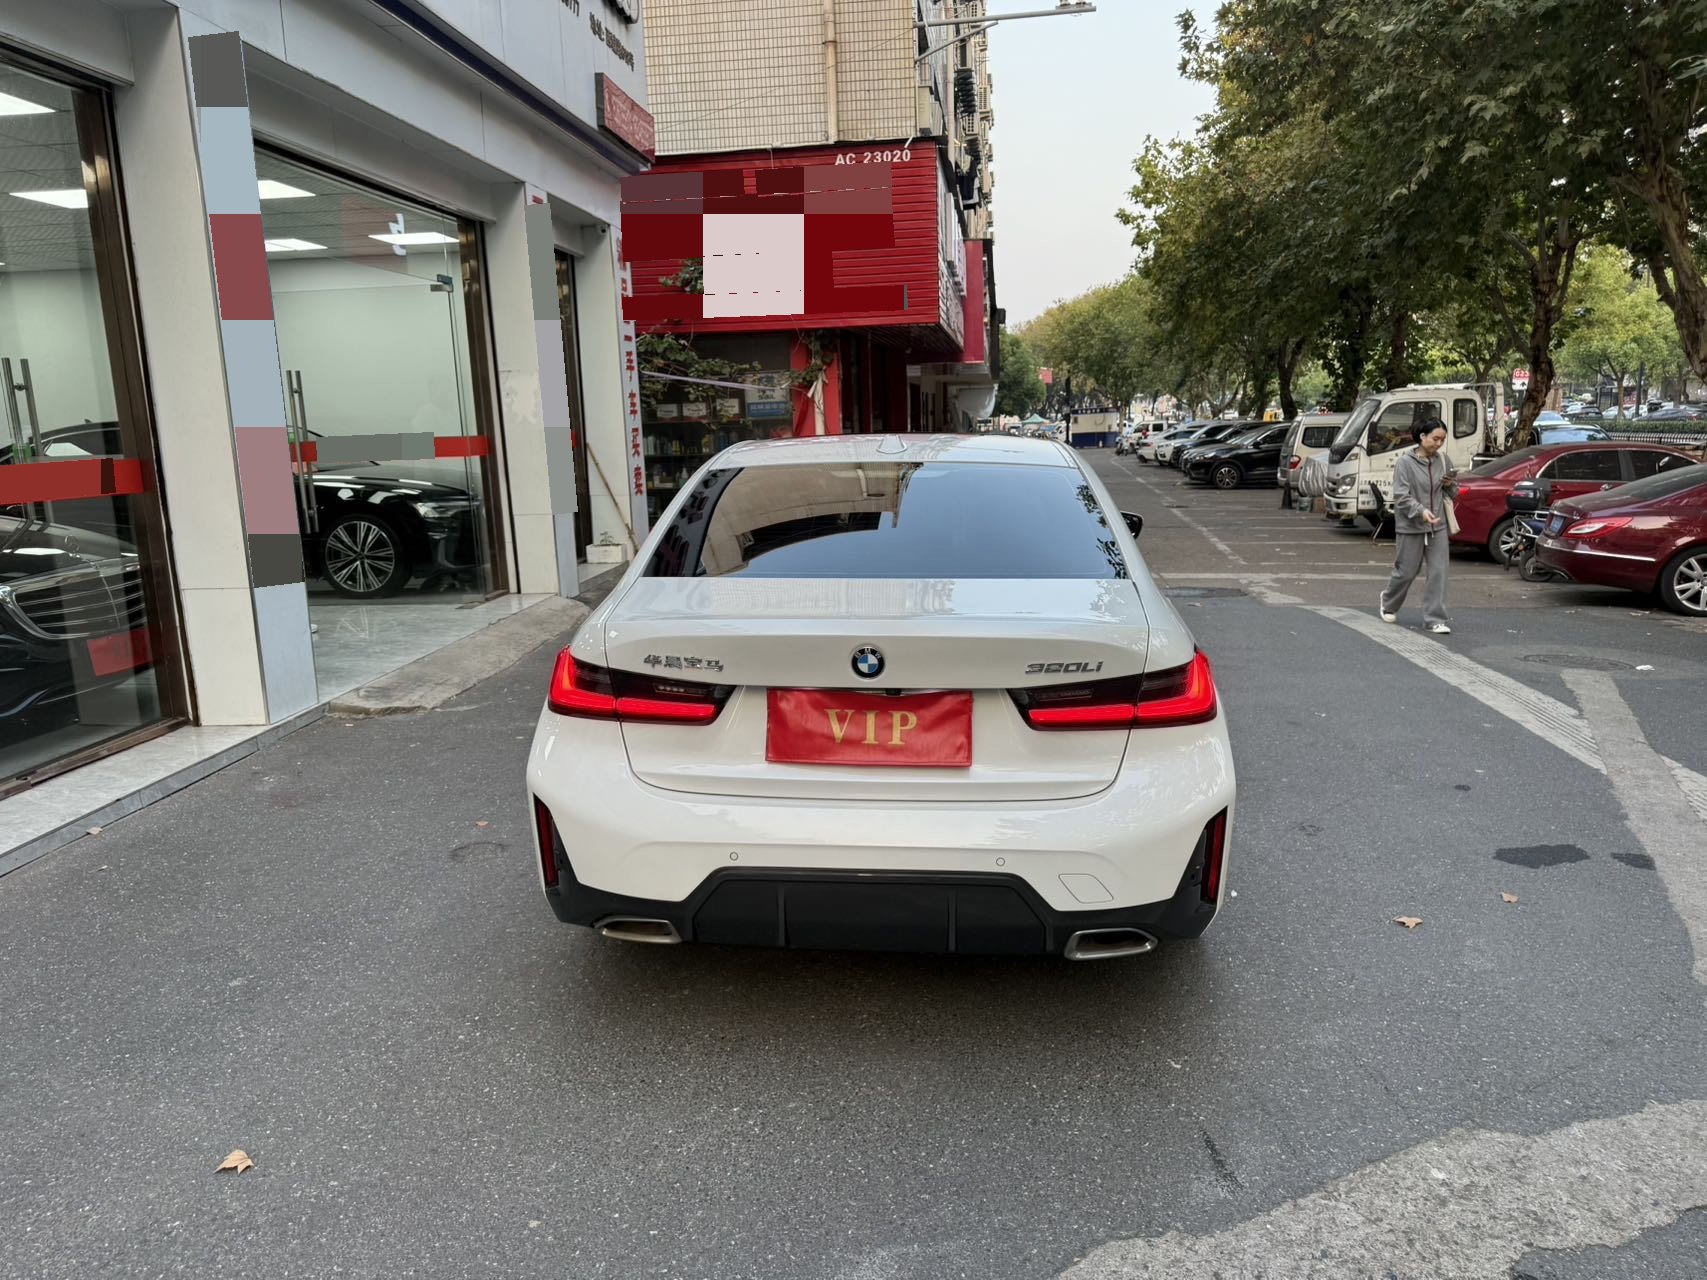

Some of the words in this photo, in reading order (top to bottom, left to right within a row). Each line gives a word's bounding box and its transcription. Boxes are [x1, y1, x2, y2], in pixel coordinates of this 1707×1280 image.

[834, 153, 857, 166] AC
[863, 149, 911, 164] 23020
[643, 654, 724, 672] 华晨宝马
[1025, 661, 1104, 675] 320Li
[824, 708, 918, 745] VIP
